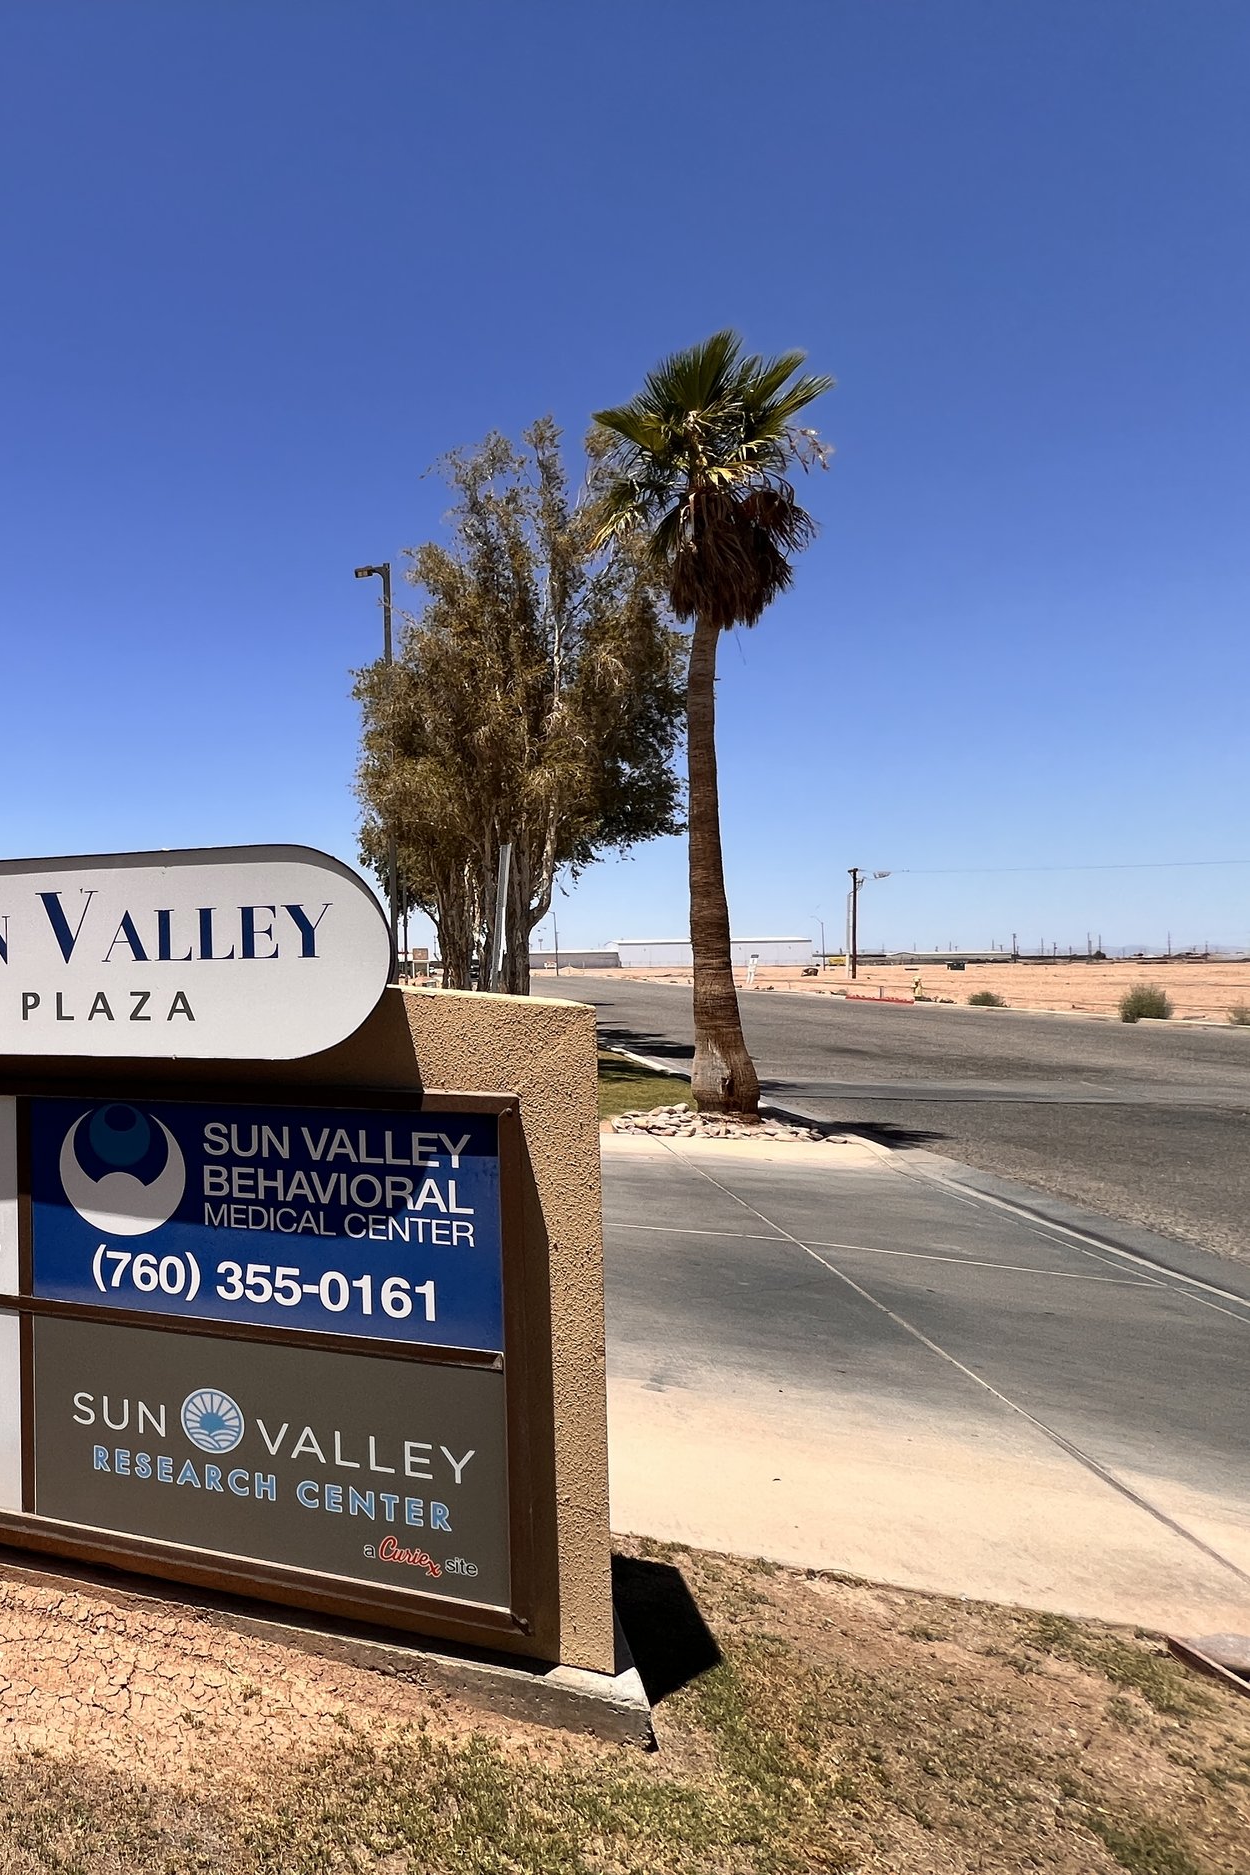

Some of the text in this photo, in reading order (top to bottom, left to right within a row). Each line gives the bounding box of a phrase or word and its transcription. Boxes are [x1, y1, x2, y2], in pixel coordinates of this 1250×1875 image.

[35, 889, 333, 965] VALLEY
[20, 991, 196, 1022] PLAZA
[203, 1122, 471, 1169] SUN VALLEY
[203, 1165, 475, 1214] BEHAVIORAL
[204, 1203, 475, 1248] MEDICAL CENTER
[92, 1243, 437, 1322] (760) 355-0161
[72, 1391, 476, 1484] SUN VALLEY
[93, 1445, 452, 1531] RESEARCH CENTER
[364, 1544, 376, 1558] a
[445, 1557, 478, 1577] site
